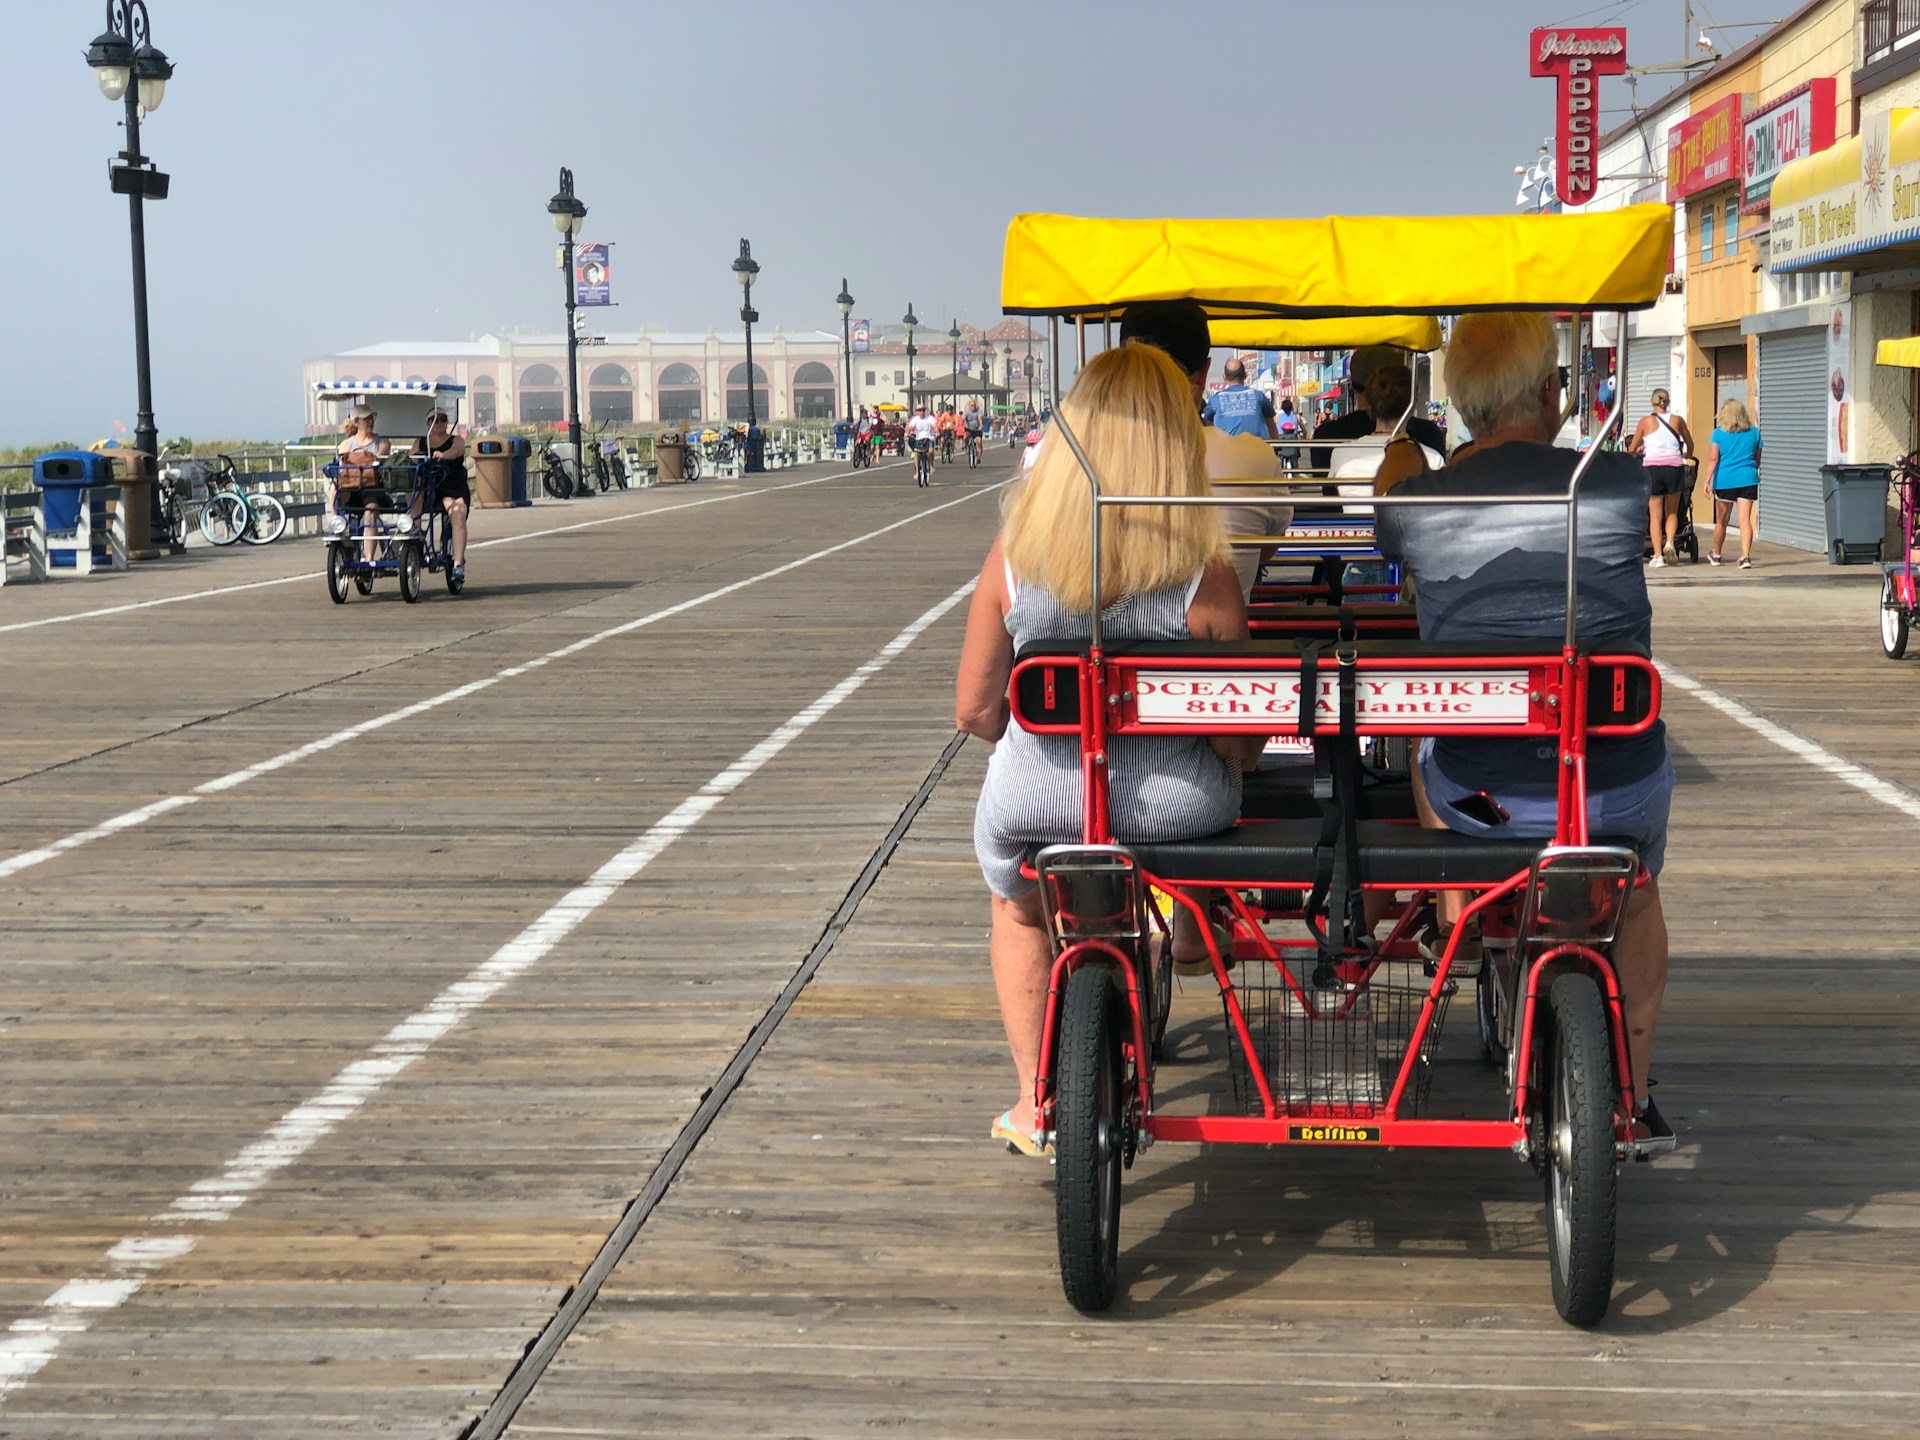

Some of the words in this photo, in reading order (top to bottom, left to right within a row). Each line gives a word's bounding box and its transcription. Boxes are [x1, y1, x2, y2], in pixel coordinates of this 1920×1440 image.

[1538, 32, 1623, 62] Johnson's
[1568, 58, 1592, 191] POPCORN
[1682, 129, 1700, 185] TIME
[1701, 107, 1729, 167] PHOTOS
[1755, 119, 1775, 177] ROMA
[1776, 106, 1801, 167] PIZZA
[1892, 174, 1920, 222] Sur
[1772, 213, 1794, 233] Surfboards
[1798, 205, 1816, 249] 7th
[1819, 190, 1857, 243] Street
[1772, 238, 1781, 255] Surf
[1781, 237, 1793, 252] Wear
[1405, 681, 1529, 696] BIKES
[1186, 700, 1252, 713] 8th
[1265, 700, 1297, 713] &
[1315, 699, 1472, 713] Alantic
[1302, 1127, 1368, 1141] Delfino
